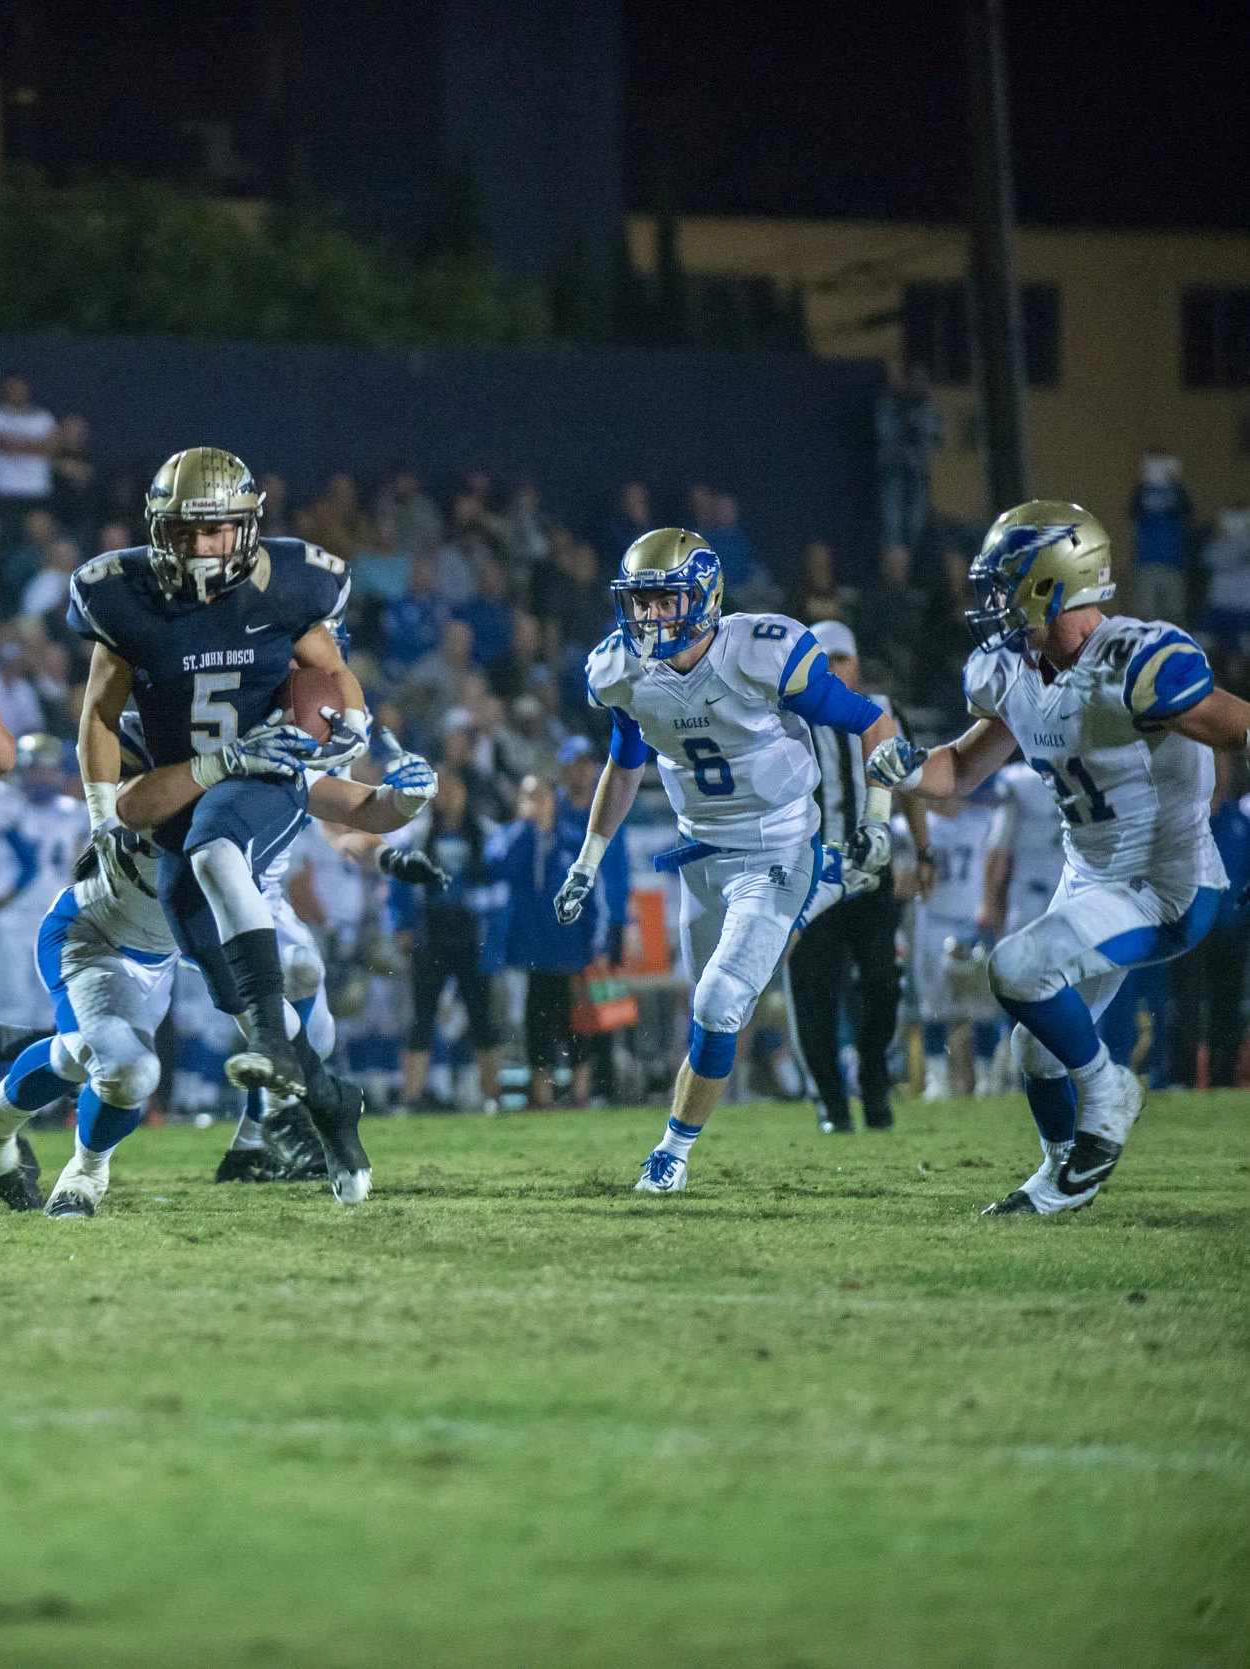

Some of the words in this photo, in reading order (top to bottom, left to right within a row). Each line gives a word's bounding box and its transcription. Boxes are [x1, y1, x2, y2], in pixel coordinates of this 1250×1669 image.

[751, 621, 788, 642] 6
[182, 654, 199, 672] ST.
[199, 650, 225, 669] JOHN
[225, 648, 255, 666] BOSCO
[190, 671, 242, 757] 5
[674, 716, 710, 730] EAGLES
[1034, 733, 1066, 748] EAGLES
[682, 737, 735, 796] 6
[1030, 755, 1118, 823] 21
